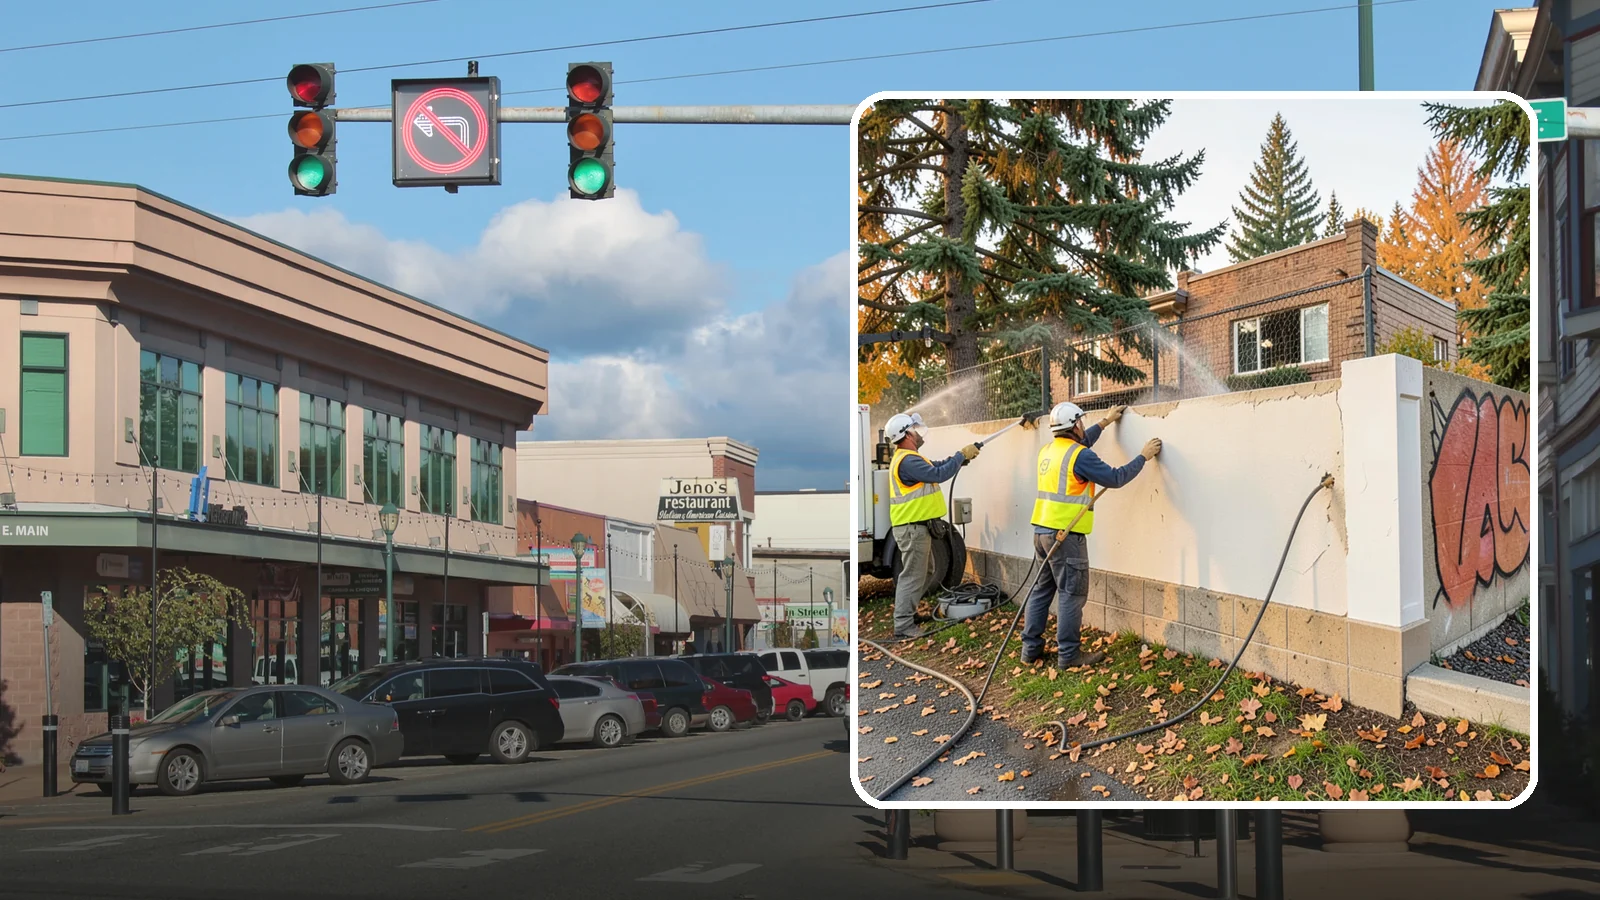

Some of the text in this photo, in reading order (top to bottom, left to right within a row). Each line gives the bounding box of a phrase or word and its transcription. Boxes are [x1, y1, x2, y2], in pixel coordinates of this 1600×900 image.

[670, 480, 727, 495] Jeno's
[665, 496, 731, 509] restaurant
[659, 510, 681, 520] Italian
[686, 510, 715, 520] American
[715, 509, 738, 519] Cuisine
[2, 525, 49, 536] E. MAIN
[797, 608, 828, 616] Street
